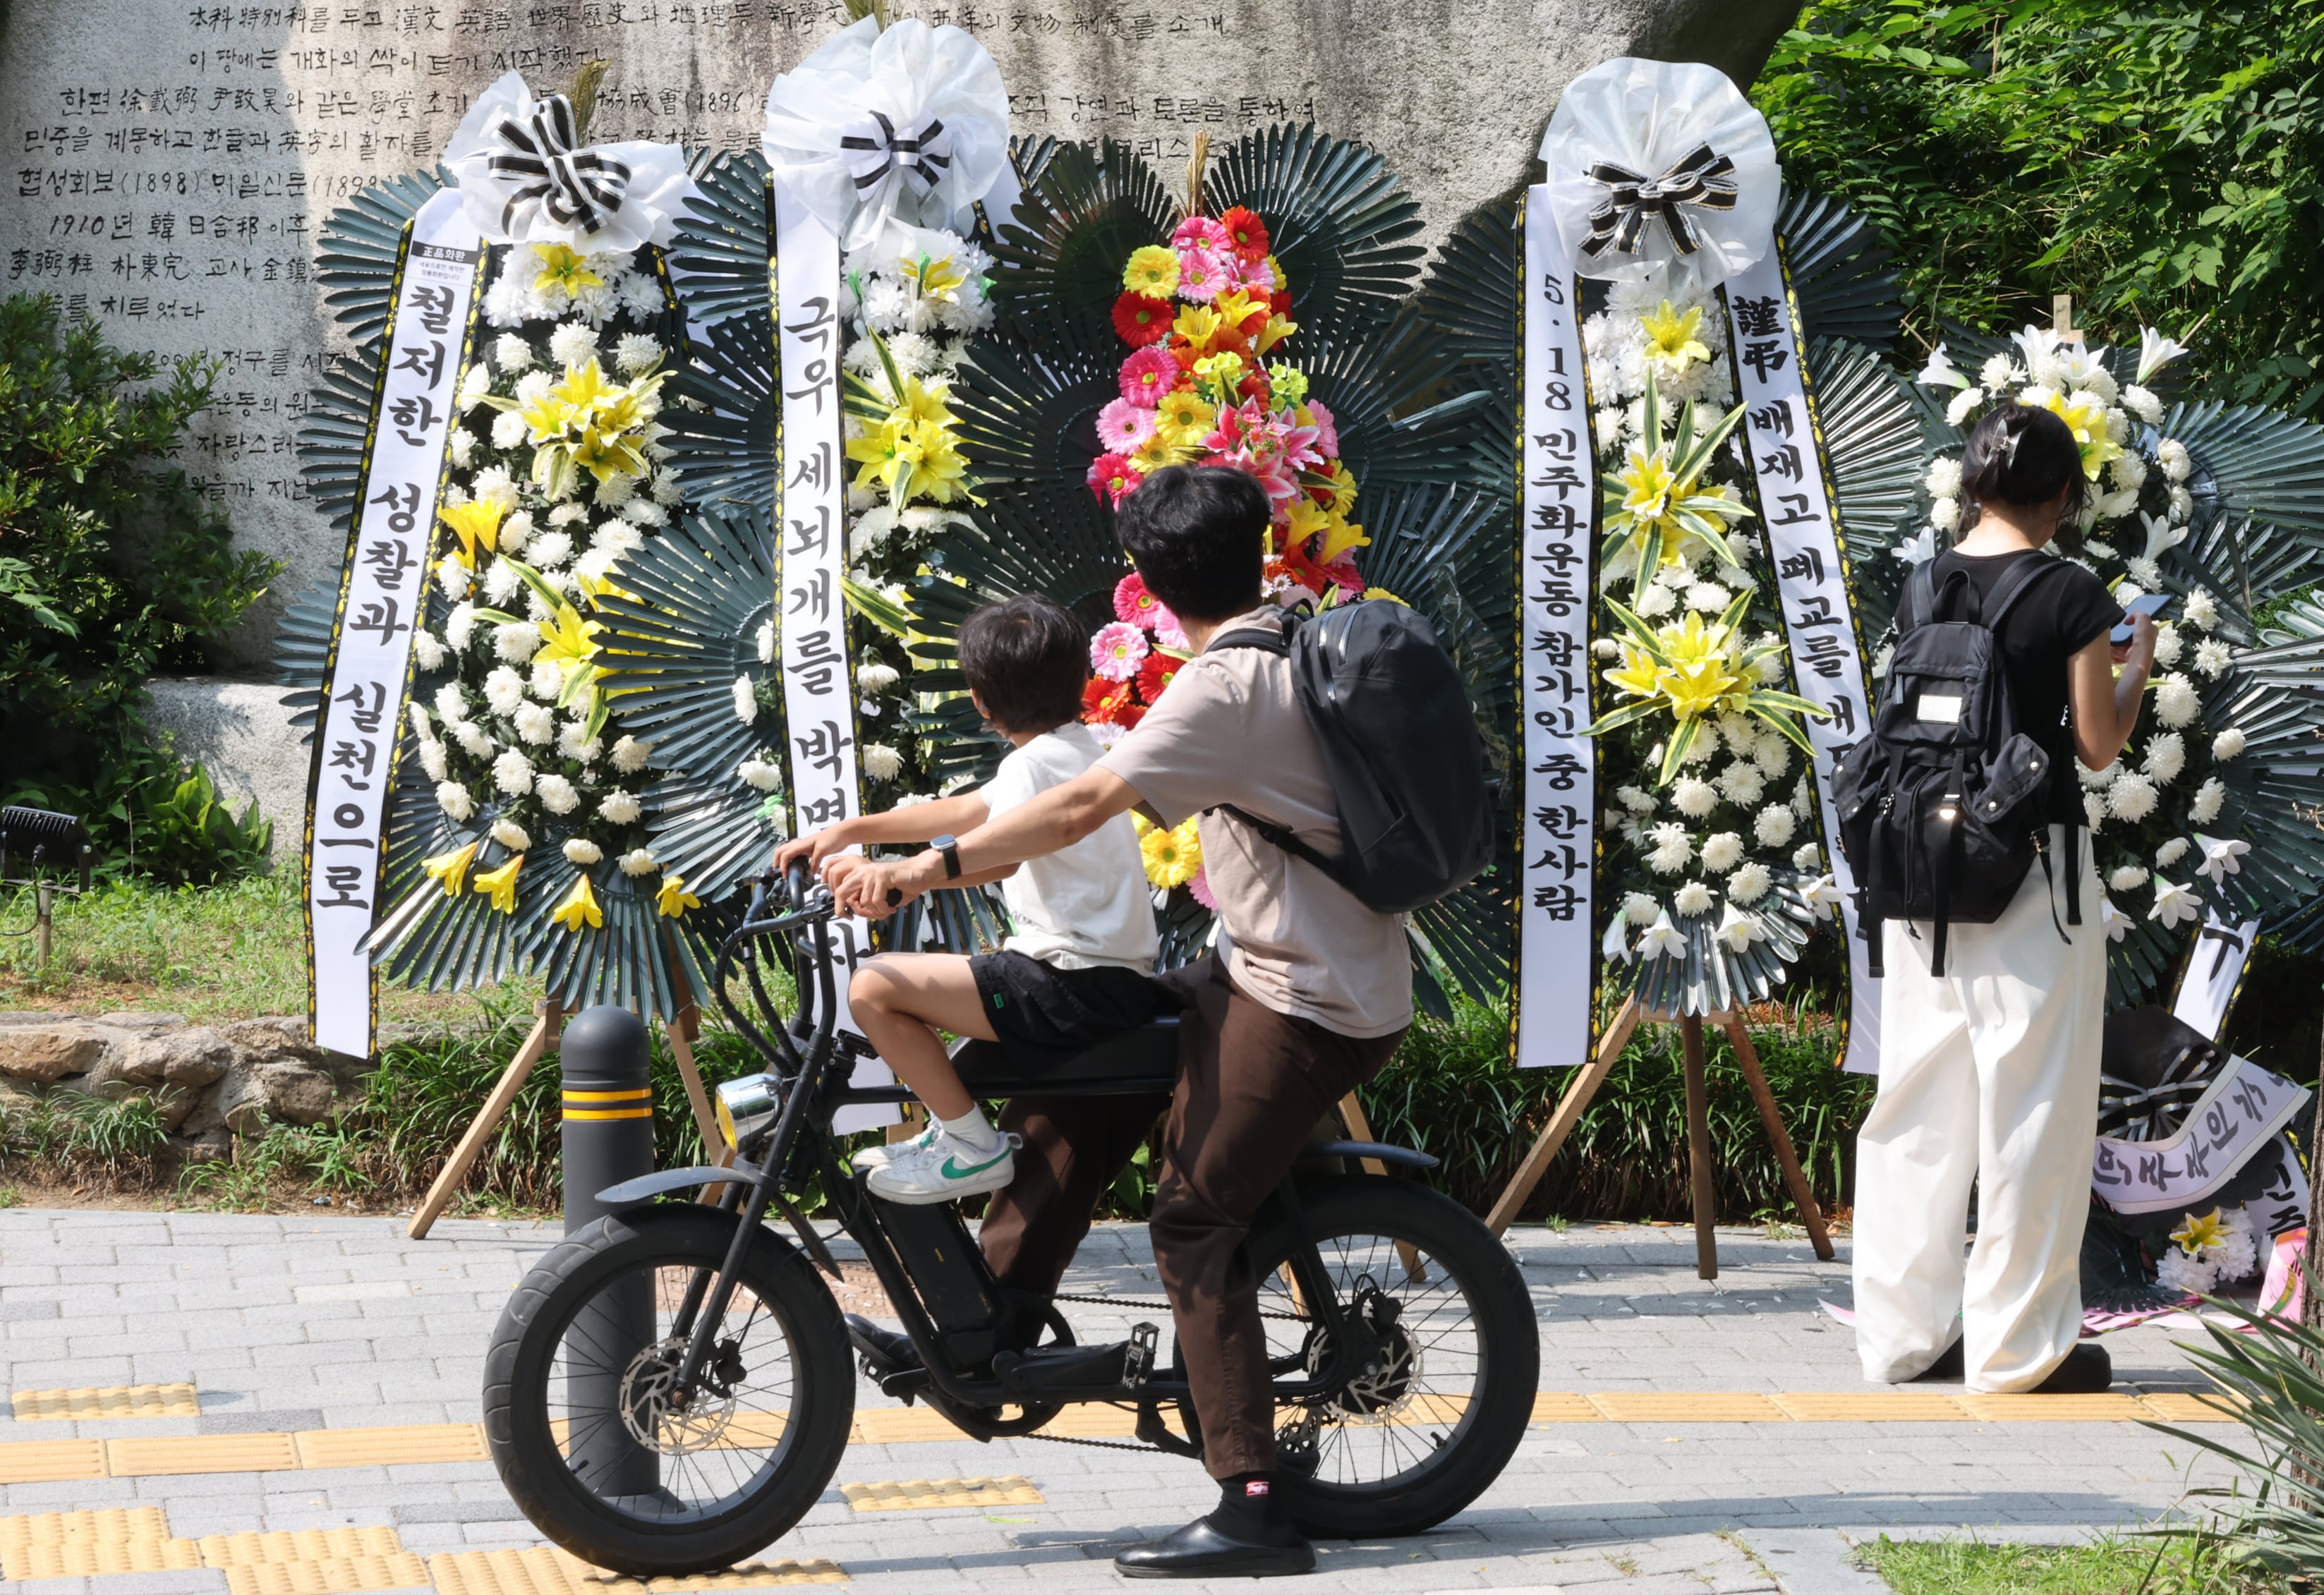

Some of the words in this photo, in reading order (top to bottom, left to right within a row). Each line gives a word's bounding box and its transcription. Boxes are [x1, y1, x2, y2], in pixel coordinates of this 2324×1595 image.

[339, 8, 383, 30] 두고
[389, 4, 444, 37] 漢文
[455, 8, 512, 34] 英語
[216, 47, 278, 73] 땅에는
[290, 47, 358, 77] 개화의
[369, 48, 417, 77] 싹이
[59, 87, 110, 116] 한편
[315, 90, 358, 119] 같은
[369, 90, 416, 124] 學堂
[1153, 96, 1226, 123] 토론을
[1237, 96, 1316, 128] 통하여
[24, 126, 93, 156] 민중을
[105, 127, 193, 154] 계몽하고
[203, 128, 271, 153] 한글과
[49, 213, 134, 241] 1910년
[270, 214, 309, 248] 이후
[423, 246, 466, 262] 正品화환
[388, 285, 456, 447] 철저한
[784, 296, 835, 417] 극우
[1731, 295, 1789, 384] 謹弔
[1748, 399, 1822, 526] 배재고
[349, 482, 423, 647] 성찰과
[1779, 546, 1851, 679] 폐교를
[316, 680, 387, 910] 실천으로
